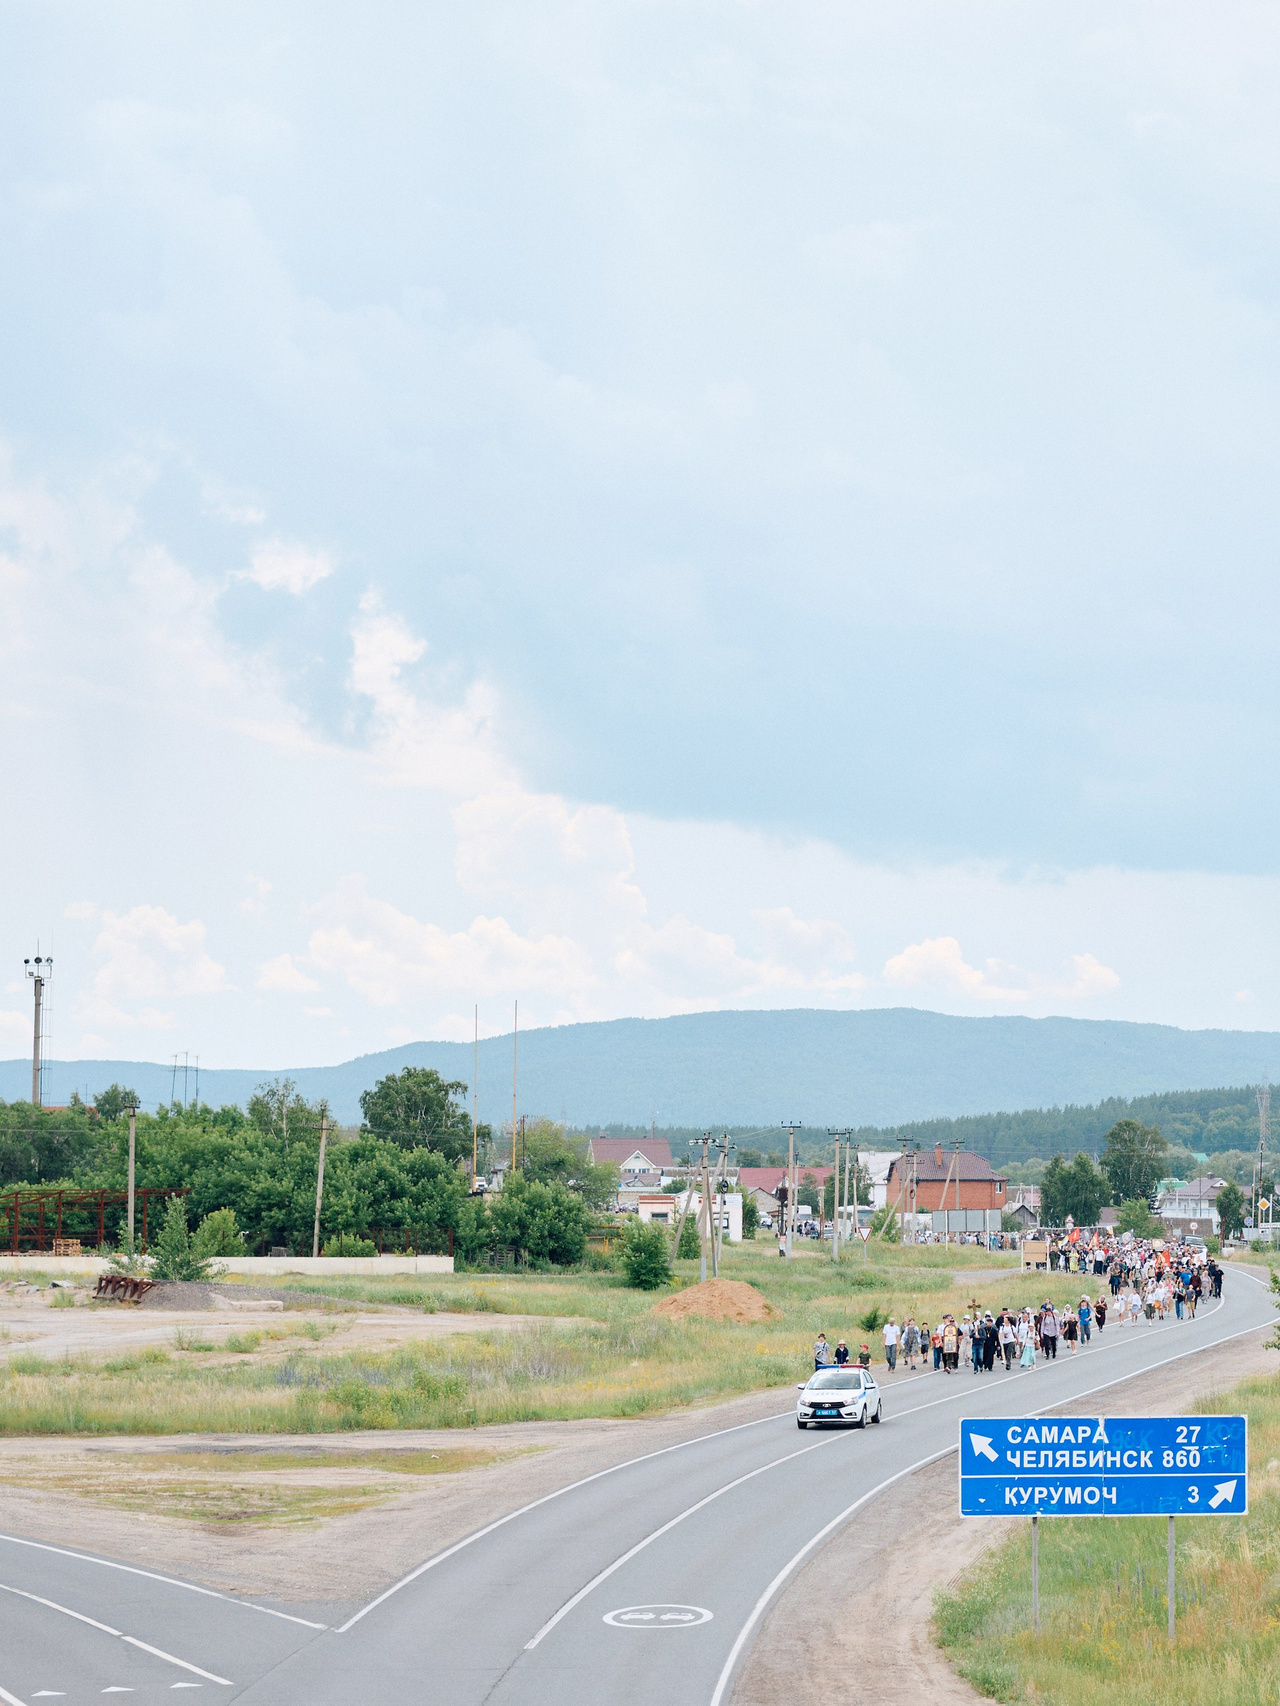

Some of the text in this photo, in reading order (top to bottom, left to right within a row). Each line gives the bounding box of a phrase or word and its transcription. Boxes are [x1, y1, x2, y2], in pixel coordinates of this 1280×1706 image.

[1006, 1425, 1110, 1444] САМАРА
[1175, 1425, 1201, 1444] 27
[1006, 1450, 1201, 1468] ЧЕЛЯБИНСК 860
[1004, 1486, 1117, 1506] КУРУМОЧ
[1187, 1485, 1200, 1504] 3
